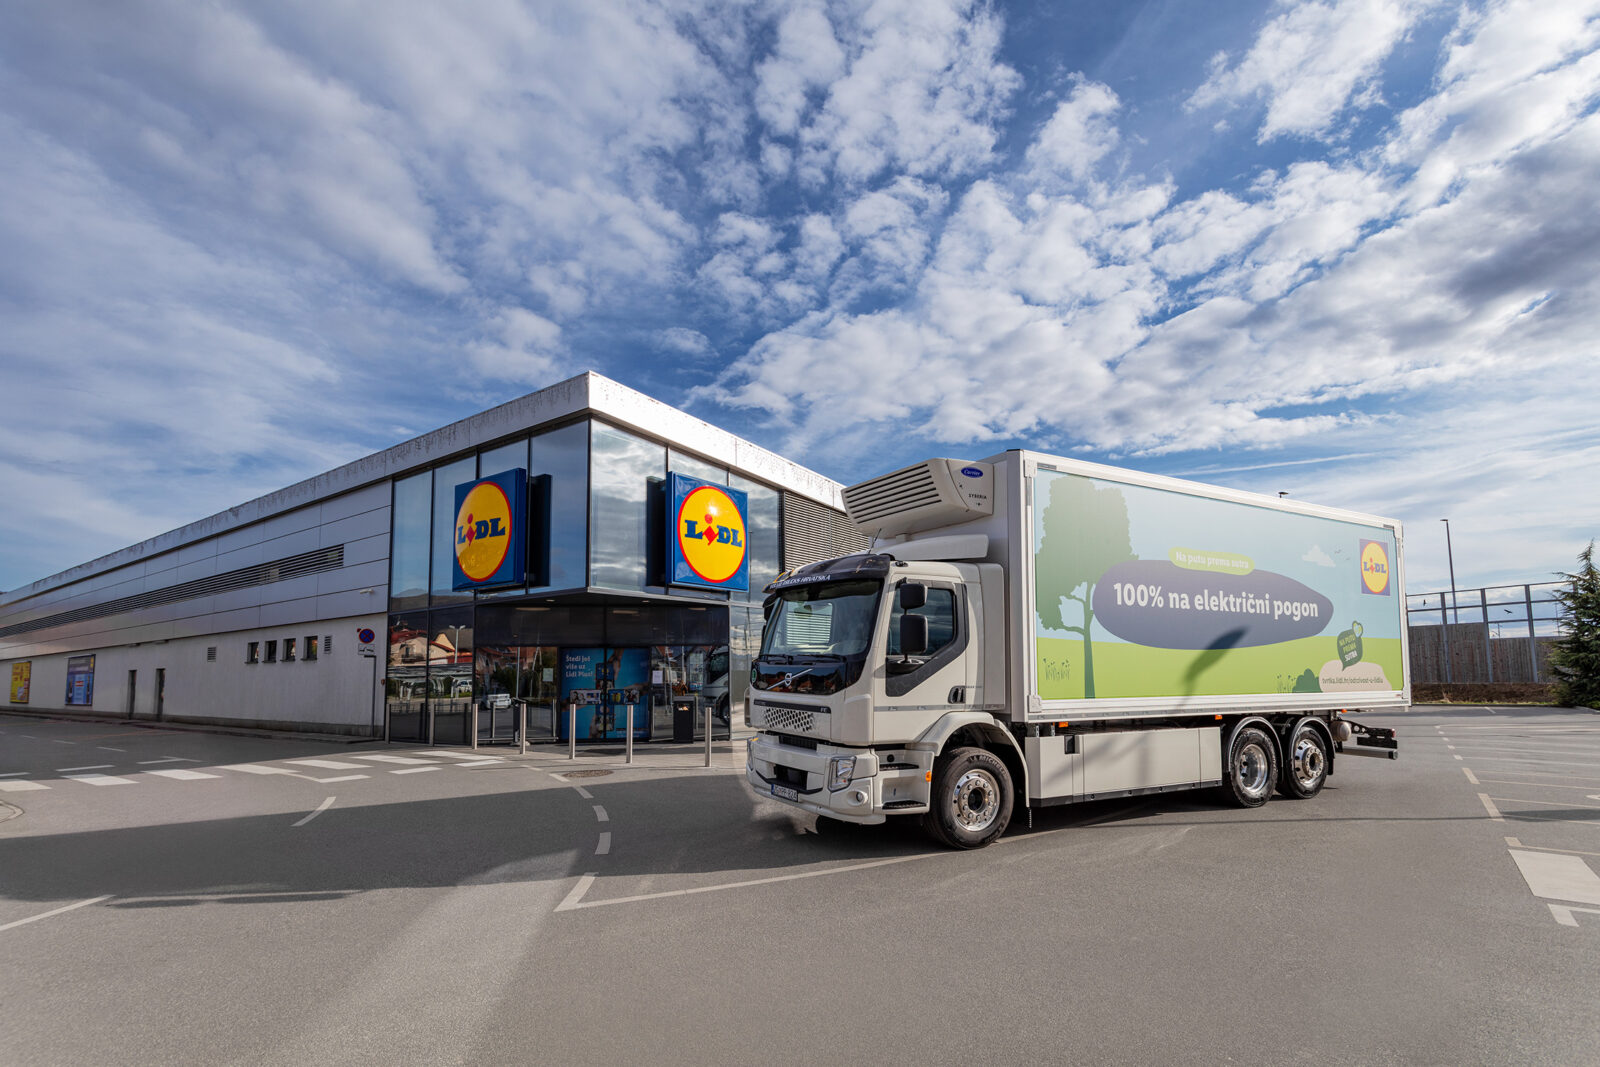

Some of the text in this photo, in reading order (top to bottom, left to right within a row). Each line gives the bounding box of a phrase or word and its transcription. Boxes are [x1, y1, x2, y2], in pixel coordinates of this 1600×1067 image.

[1176, 552, 1248, 568] Na putu prema sutra
[1114, 582, 1318, 622] 100% na električni pogon
